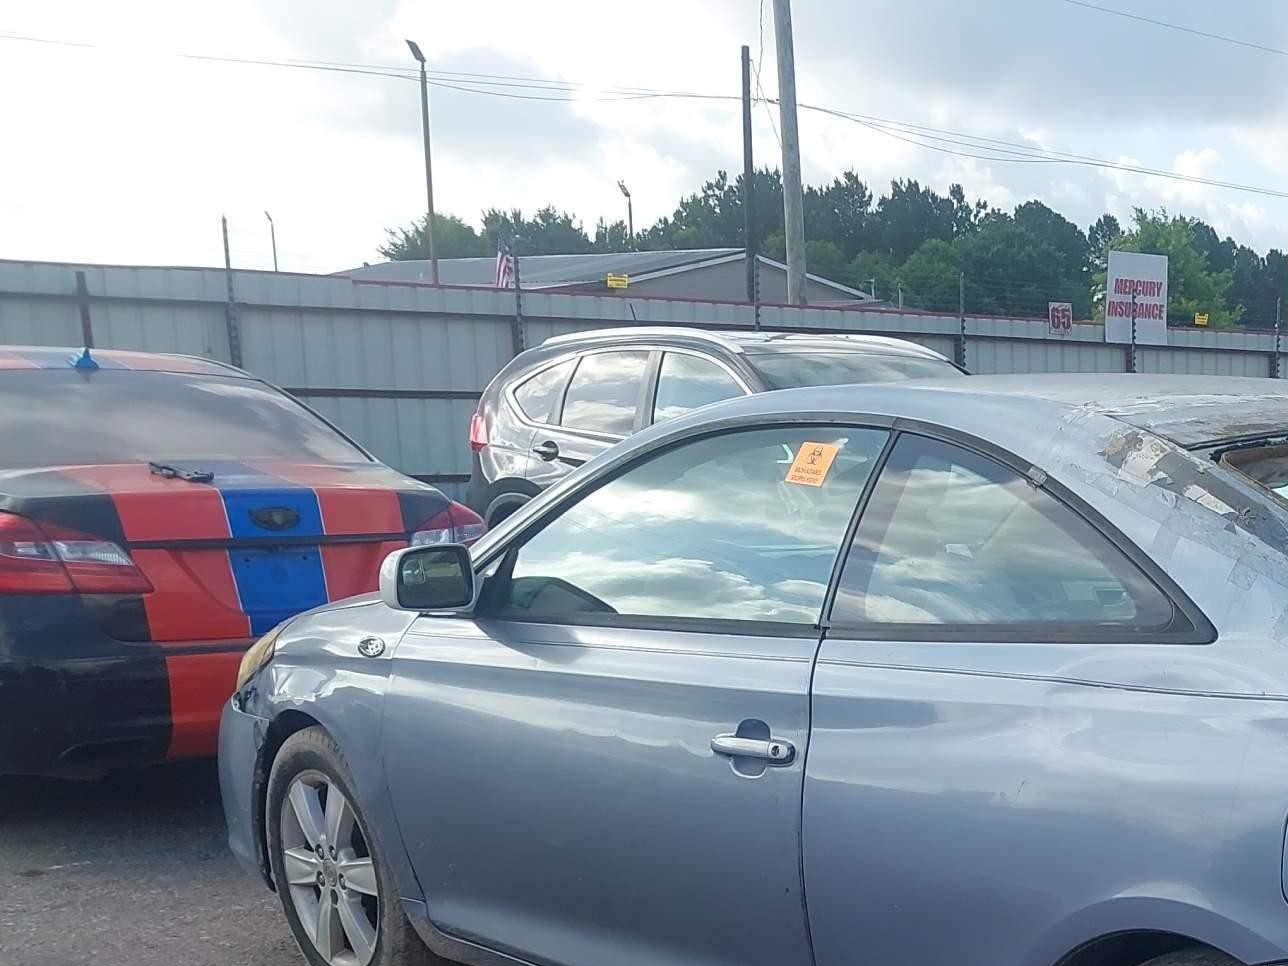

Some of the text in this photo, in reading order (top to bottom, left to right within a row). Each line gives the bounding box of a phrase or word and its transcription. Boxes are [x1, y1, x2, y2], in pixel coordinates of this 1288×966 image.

[1114, 278, 1163, 298] MERCURY
[1051, 306, 1072, 330] 65
[1108, 300, 1165, 320] INSURANCE
